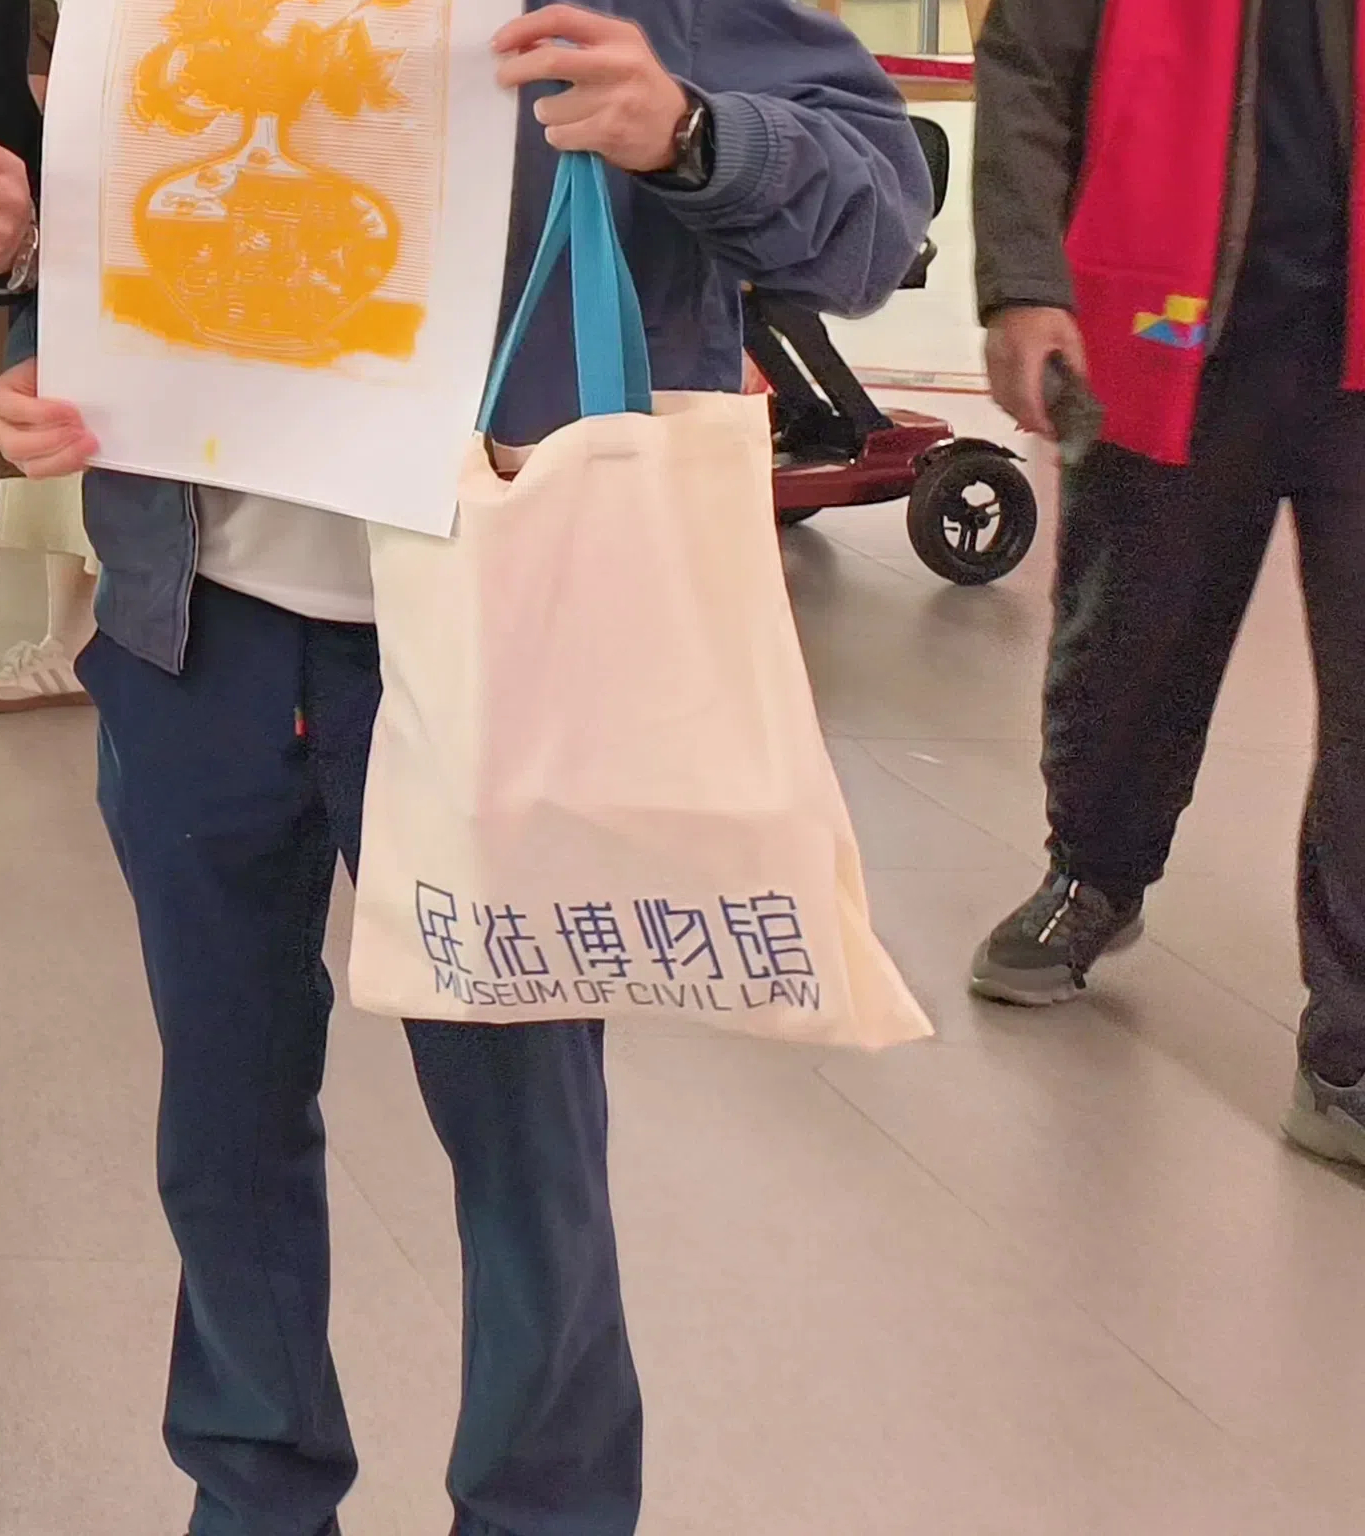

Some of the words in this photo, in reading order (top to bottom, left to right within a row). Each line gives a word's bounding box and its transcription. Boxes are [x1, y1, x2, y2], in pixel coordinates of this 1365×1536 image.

[434, 965, 570, 1007] MUSEUM
[573, 979, 617, 1004] OF
[626, 982, 733, 1011] CIVIL
[739, 981, 821, 1011] LAW
